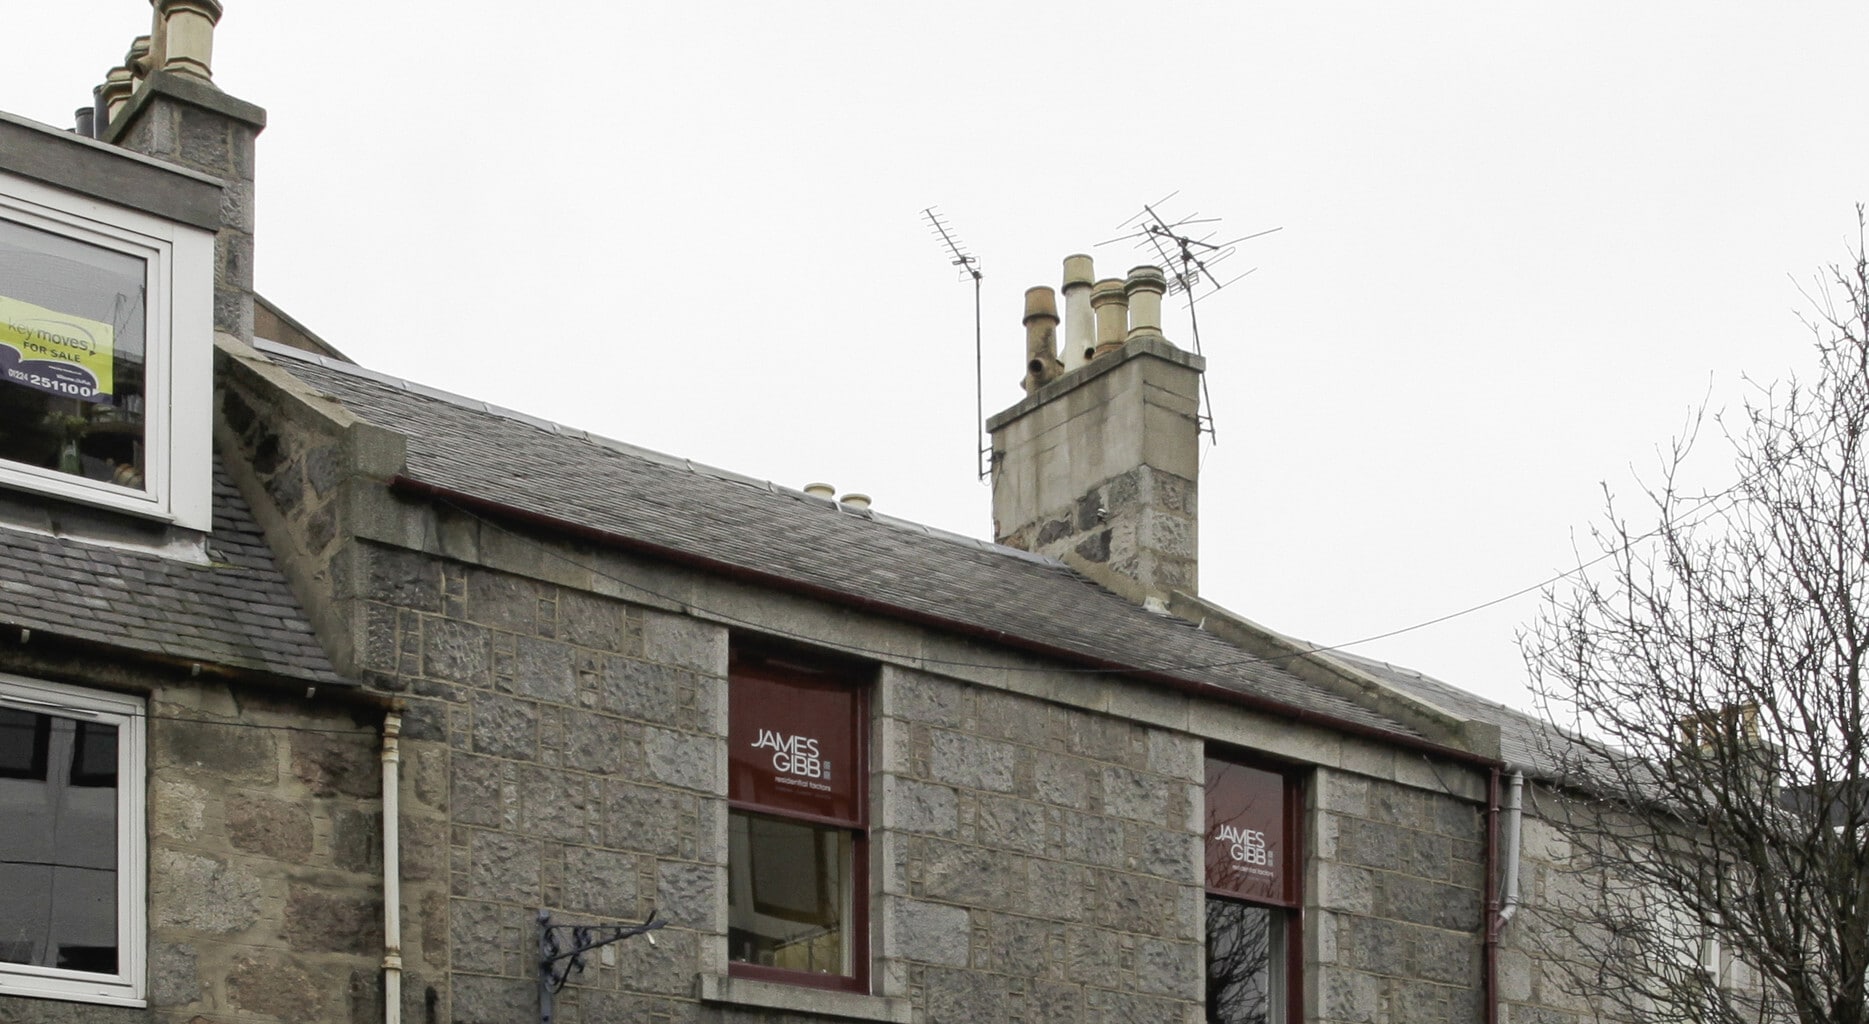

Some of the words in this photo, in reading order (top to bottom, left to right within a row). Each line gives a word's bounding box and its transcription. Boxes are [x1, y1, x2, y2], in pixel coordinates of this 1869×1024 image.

[23, 341, 48, 355] FOR
[50, 349, 81, 363] SALE
[30, 374, 91, 397] 251100
[751, 728, 820, 758] JAMES
[773, 752, 821, 778] GIBB
[1215, 824, 1265, 849] JAMES
[1230, 843, 1266, 866] GIBB
